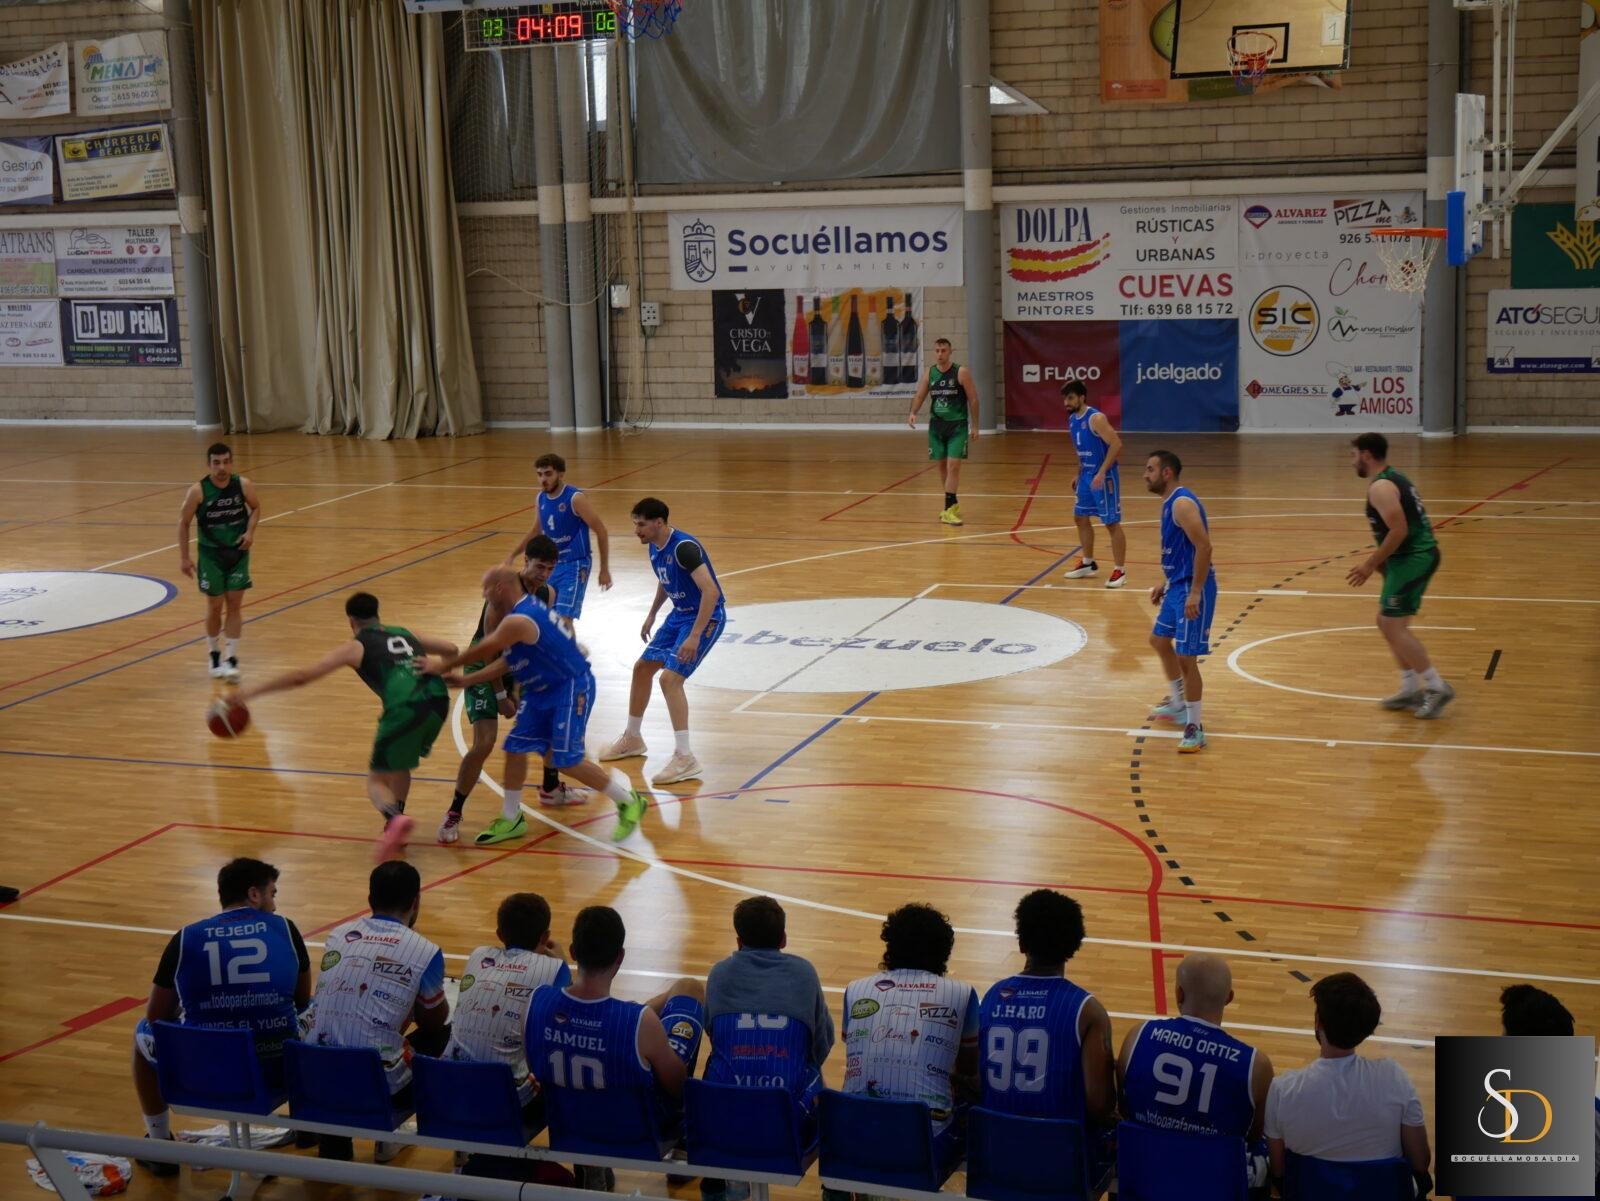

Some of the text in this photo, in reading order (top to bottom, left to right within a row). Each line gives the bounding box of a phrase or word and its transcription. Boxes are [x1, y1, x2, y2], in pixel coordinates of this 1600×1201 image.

[483, 18, 503, 37] 03
[517, 14, 582, 40] 04:09
[91, 62, 136, 80] MENA
[1120, 205, 1166, 215] Gestiones
[1275, 208, 1328, 218] ALVAREZ
[1334, 199, 1391, 226] PIZZA
[128, 229, 155, 237] TALLER
[1016, 207, 1092, 243] DOLPA
[1136, 218, 1214, 234] RÚSTICAS
[727, 225, 949, 256] Socuéllamos
[1340, 234, 1361, 244] 926
[1136, 248, 1215, 262] URBANAS
[754, 262, 944, 272] AYUNTAMIENTO
[1119, 273, 1234, 298] CUEVAS
[1018, 291, 1094, 302] MAESTROS
[1018, 306, 1094, 316] PINTORES
[1148, 304, 1172, 316] 639
[1176, 304, 1192, 315] 68
[1197, 304, 1212, 315] 15
[1217, 303, 1233, 314] 72
[1258, 308, 1312, 324] SIC
[102, 310, 124, 334] EDU
[130, 306, 163, 334] PEÑA
[730, 328, 767, 339] CRISTO
[730, 340, 772, 352] VEGA
[1045, 366, 1101, 381] FLACO
[1136, 363, 1222, 384] j.delgado
[1373, 376, 1405, 394] LOS
[1360, 397, 1413, 414] AMIGOS
[546, 514, 556, 530] 4
[387, 636, 414, 656] 9
[717, 630, 1038, 655] abezuelo
[475, 699, 488, 710] 21
[204, 922, 268, 938] TEJEDA
[203, 938, 270, 986] 12
[372, 962, 412, 977] PIZZA
[504, 987, 534, 998] PIZZ
[920, 1007, 958, 1018] PIZZA
[992, 1005, 1046, 1020] J.HARO
[258, 1016, 288, 1030] YUGO
[544, 1028, 606, 1052] SAMUEL
[1150, 1028, 1193, 1049] MARIO
[1196, 1040, 1240, 1062] ORTIZ
[988, 1026, 1049, 1092] 99
[549, 1050, 606, 1090] 10
[1152, 1052, 1218, 1114] 91
